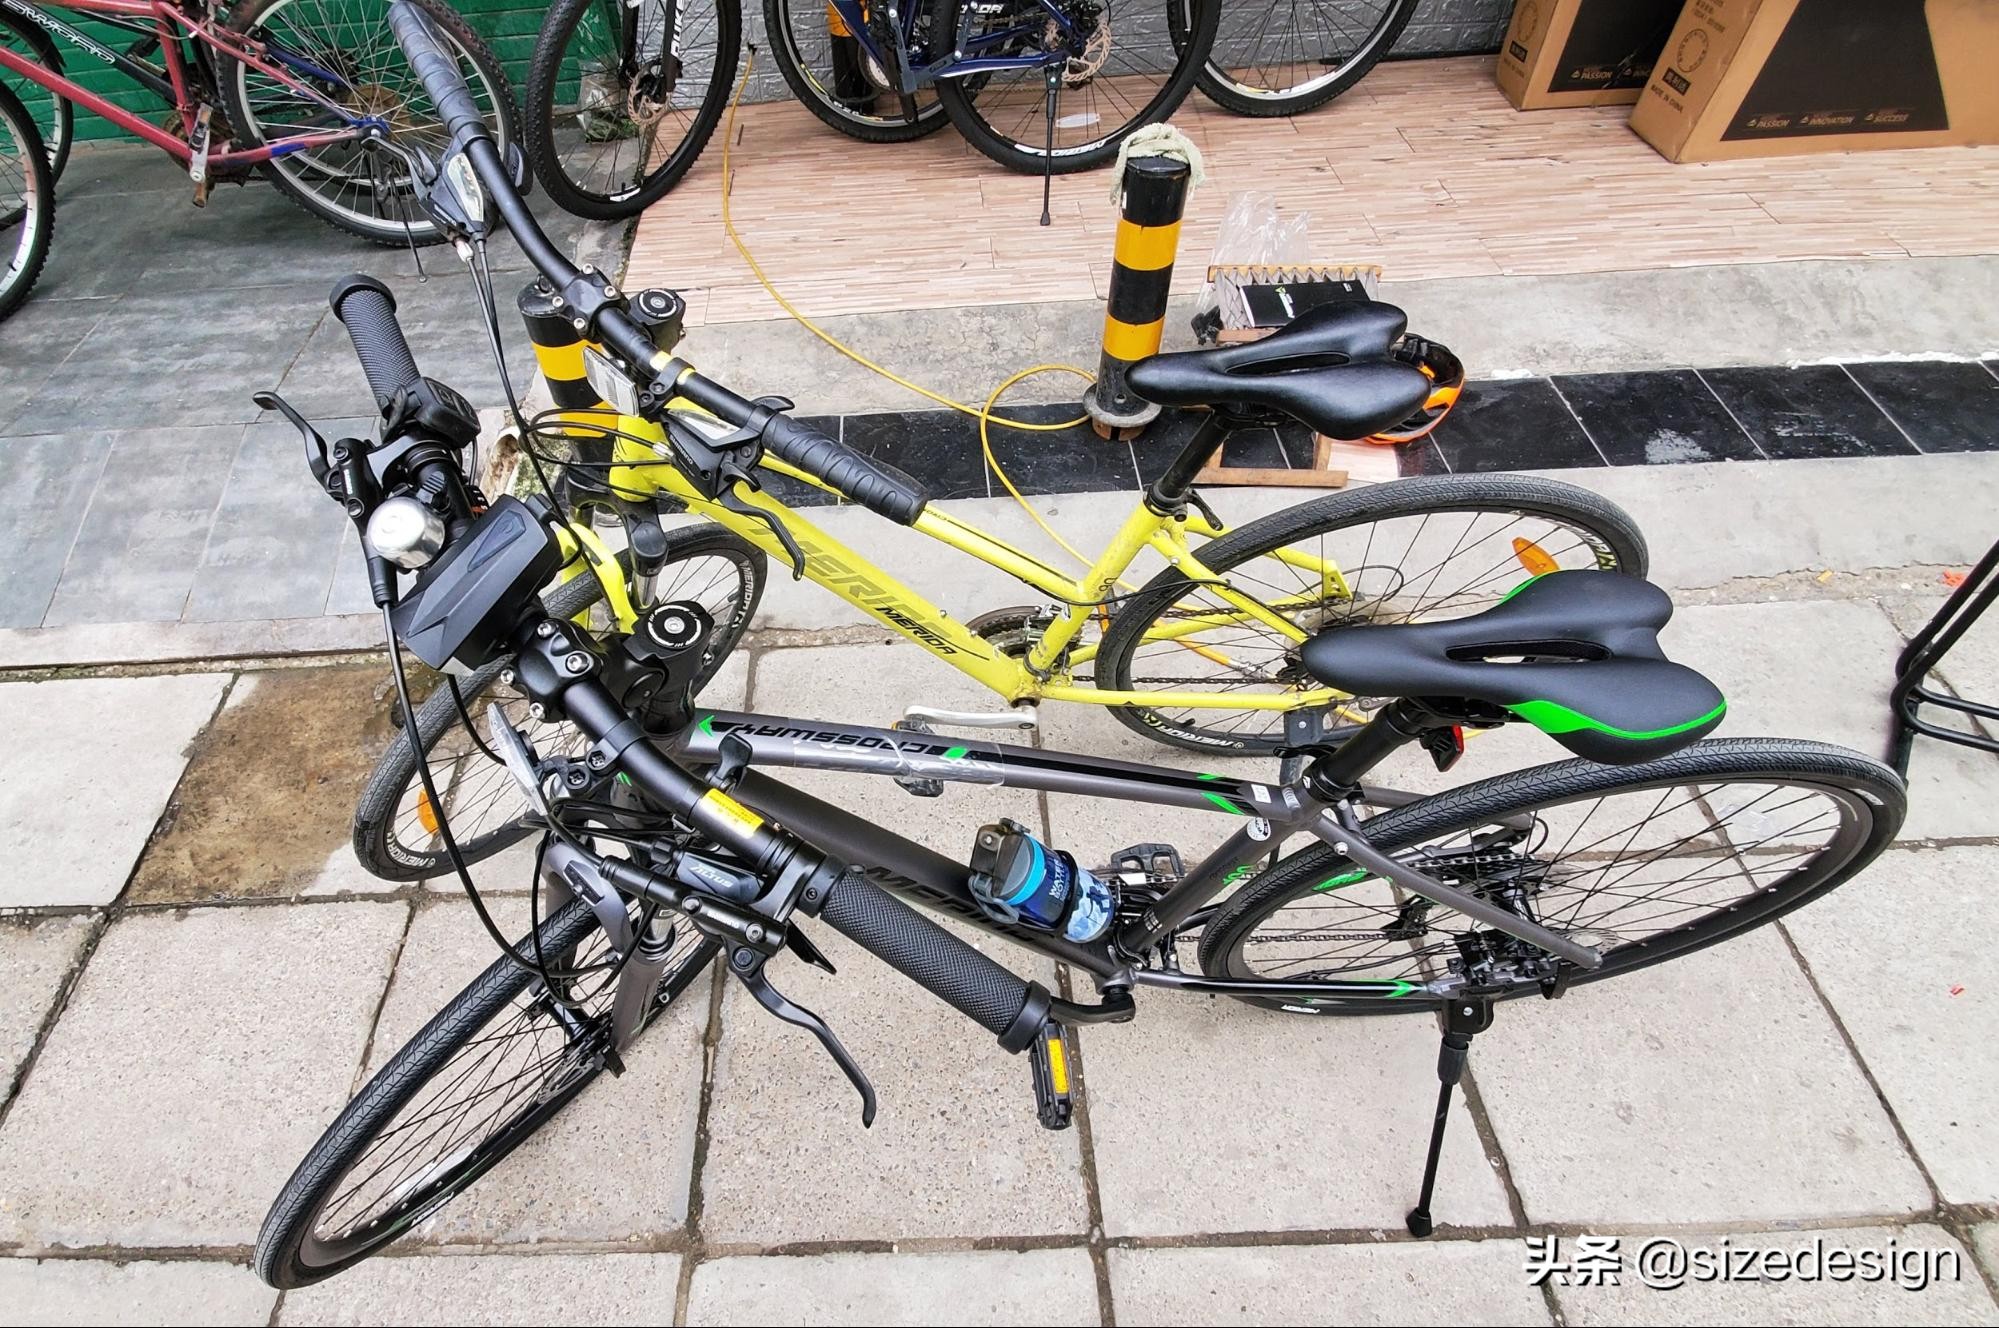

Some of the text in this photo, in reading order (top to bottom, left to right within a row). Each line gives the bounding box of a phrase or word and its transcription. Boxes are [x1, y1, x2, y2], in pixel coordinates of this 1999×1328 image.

[1757, 119, 1791, 129] PASSION
[1808, 116, 1855, 127] INNOVATION
[1874, 113, 1910, 123] SUCCESS
[669, 433, 694, 465] SHIMANO
[741, 565, 754, 610] MERIDA
[875, 604, 957, 656] MERIDA
[736, 723, 926, 755] CROSSWAY
[1157, 726, 1234, 747] MERIDA
[387, 842, 429, 867] MERIDA
[689, 863, 734, 888] ALTUS
